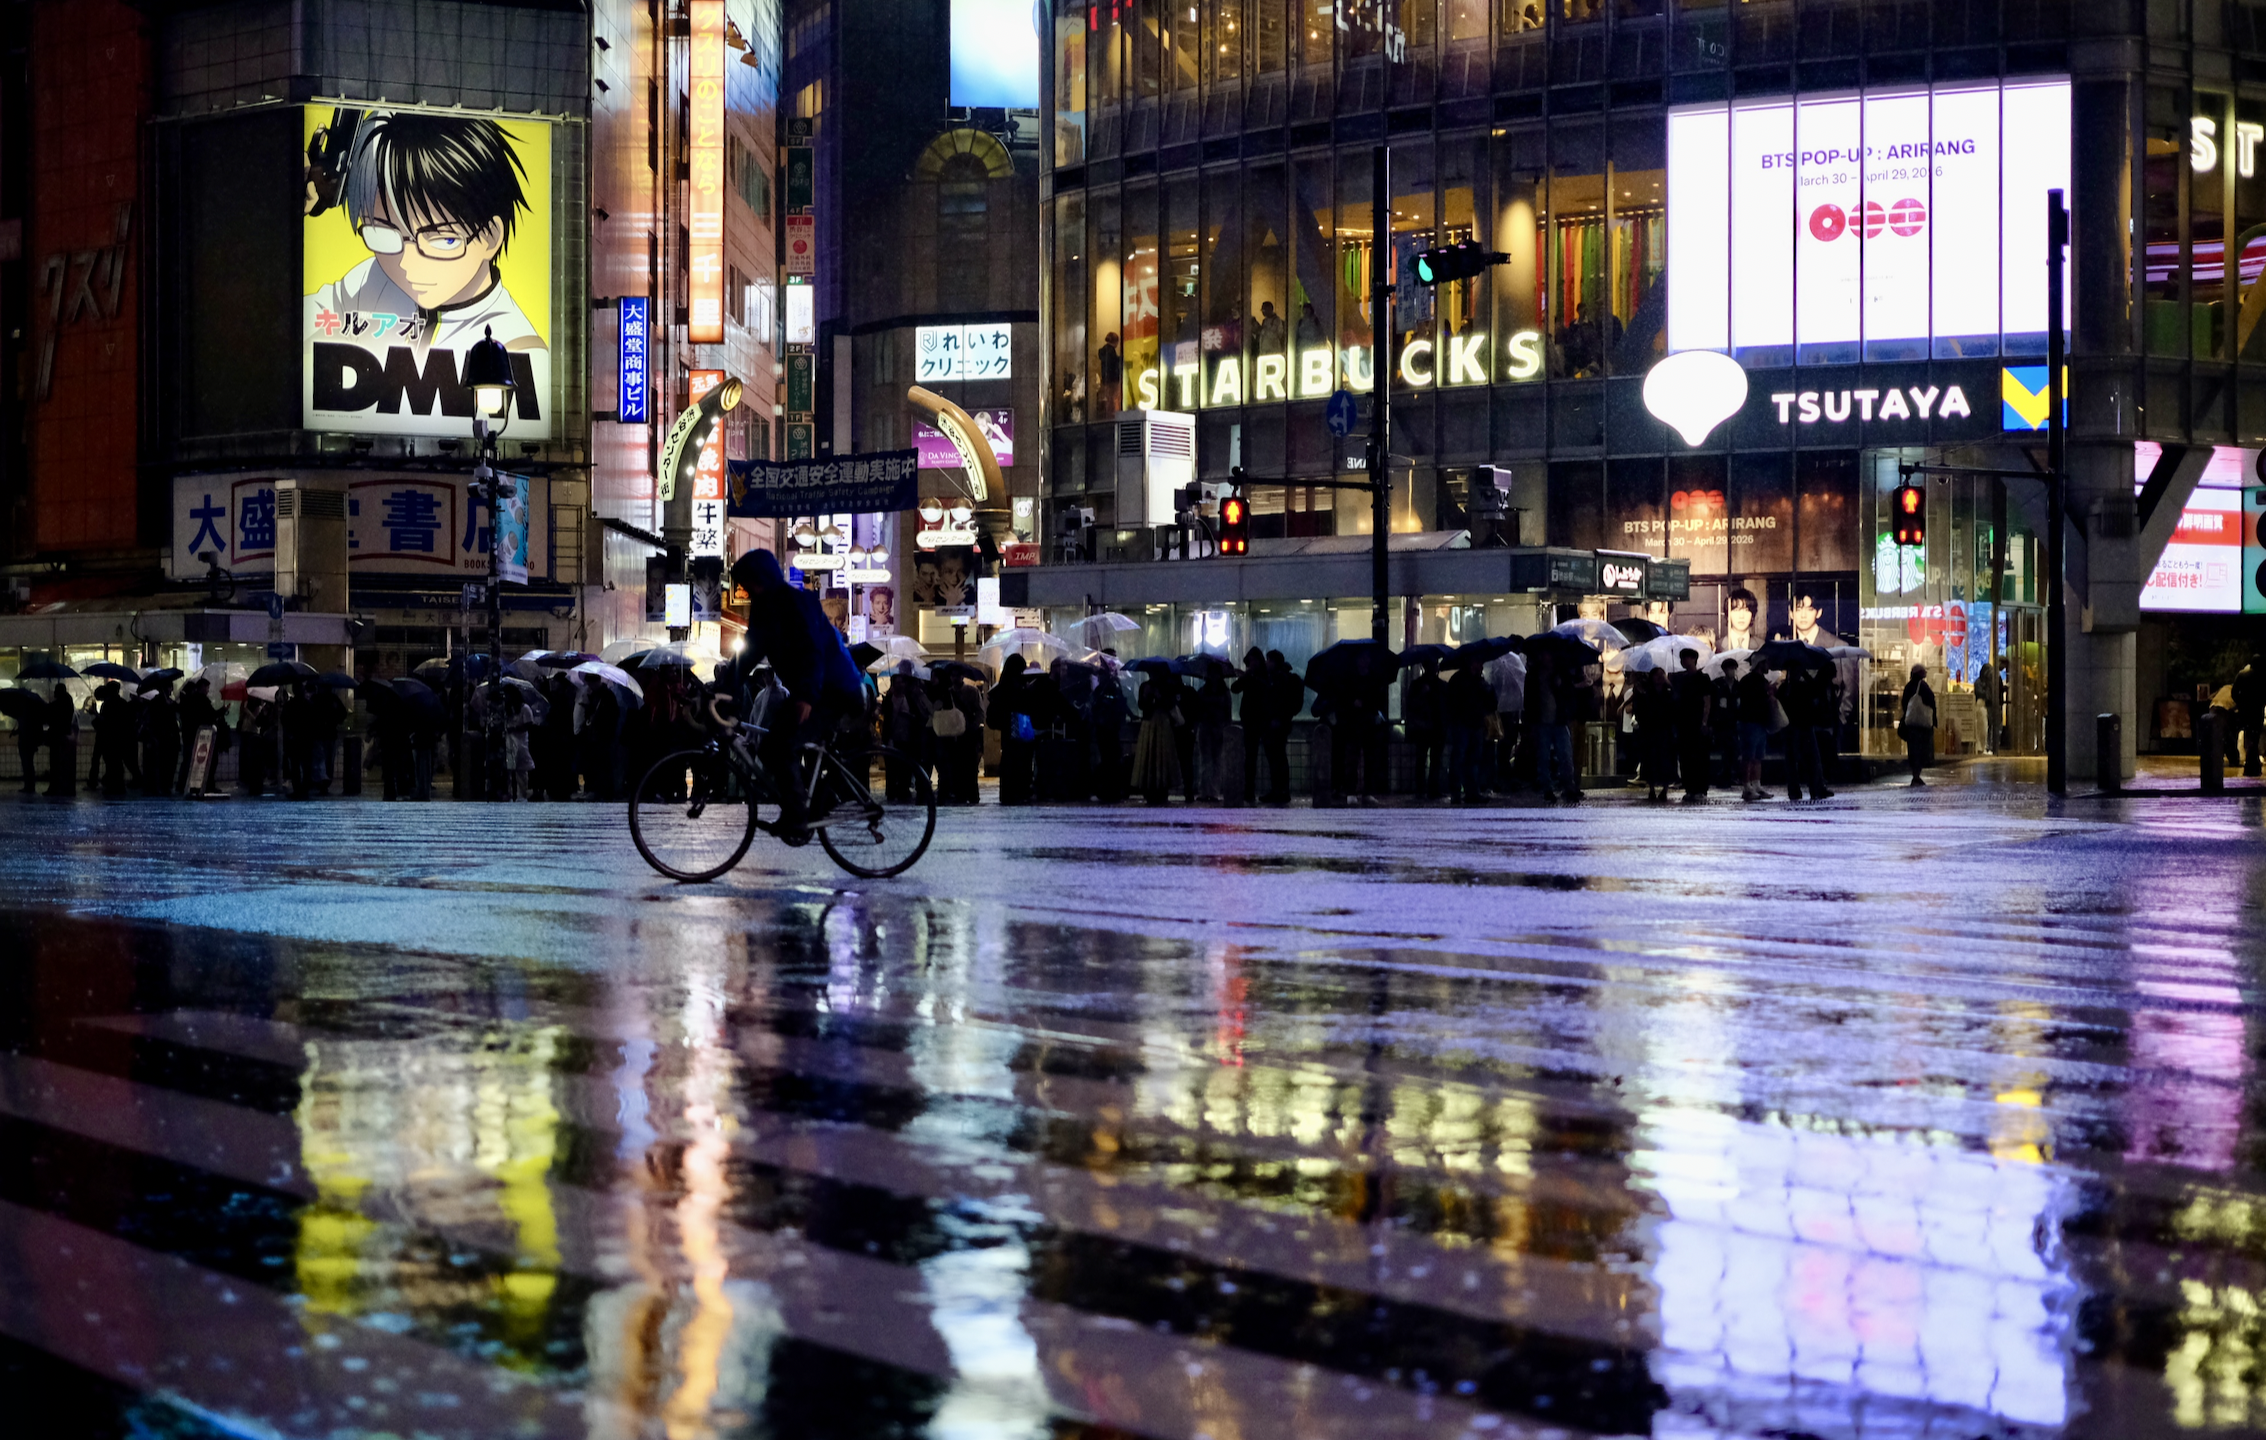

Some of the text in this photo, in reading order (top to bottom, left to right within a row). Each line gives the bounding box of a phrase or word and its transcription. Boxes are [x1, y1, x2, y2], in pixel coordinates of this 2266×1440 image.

[692, 9, 721, 326] クスリのことなら 三千里
[1761, 153, 1794, 169] BTS
[1801, 147, 1873, 167] POP-UP
[1886, 138, 1976, 160] ARIRANG
[1800, 175, 1829, 187] arch
[1832, 172, 1847, 184] 30
[1892, 168, 1909, 182] 29,
[1912, 166, 1943, 180] 206
[789, 275, 802, 284] 3F
[314, 308, 425, 339] キルアオ
[943, 329, 1009, 352] れいわ
[624, 304, 643, 417] 大盛堂商事ビル
[920, 355, 1009, 377] クリニック
[1138, 331, 1541, 411] STARBUCKS
[1772, 385, 1971, 424] TSUTAYA
[661, 408, 696, 498] 渋谷センター街
[928, 451, 962, 460] DA VINC
[750, 455, 916, 489] 全国交通安全運動実施中
[766, 485, 895, 501] National Traffic Safety Campaign
[188, 489, 490, 556] 大盛書
[695, 502, 717, 550] 牛繁
[1624, 520, 1650, 534] BTS
[1652, 518, 1704, 533] POP-UP
[1712, 516, 1777, 531] ARIRANG
[1673, 537, 1685, 547] 30
[1694, 535, 1714, 548] April
[1731, 534, 1754, 545] 2026
[421, 595, 462, 605] TAISE
